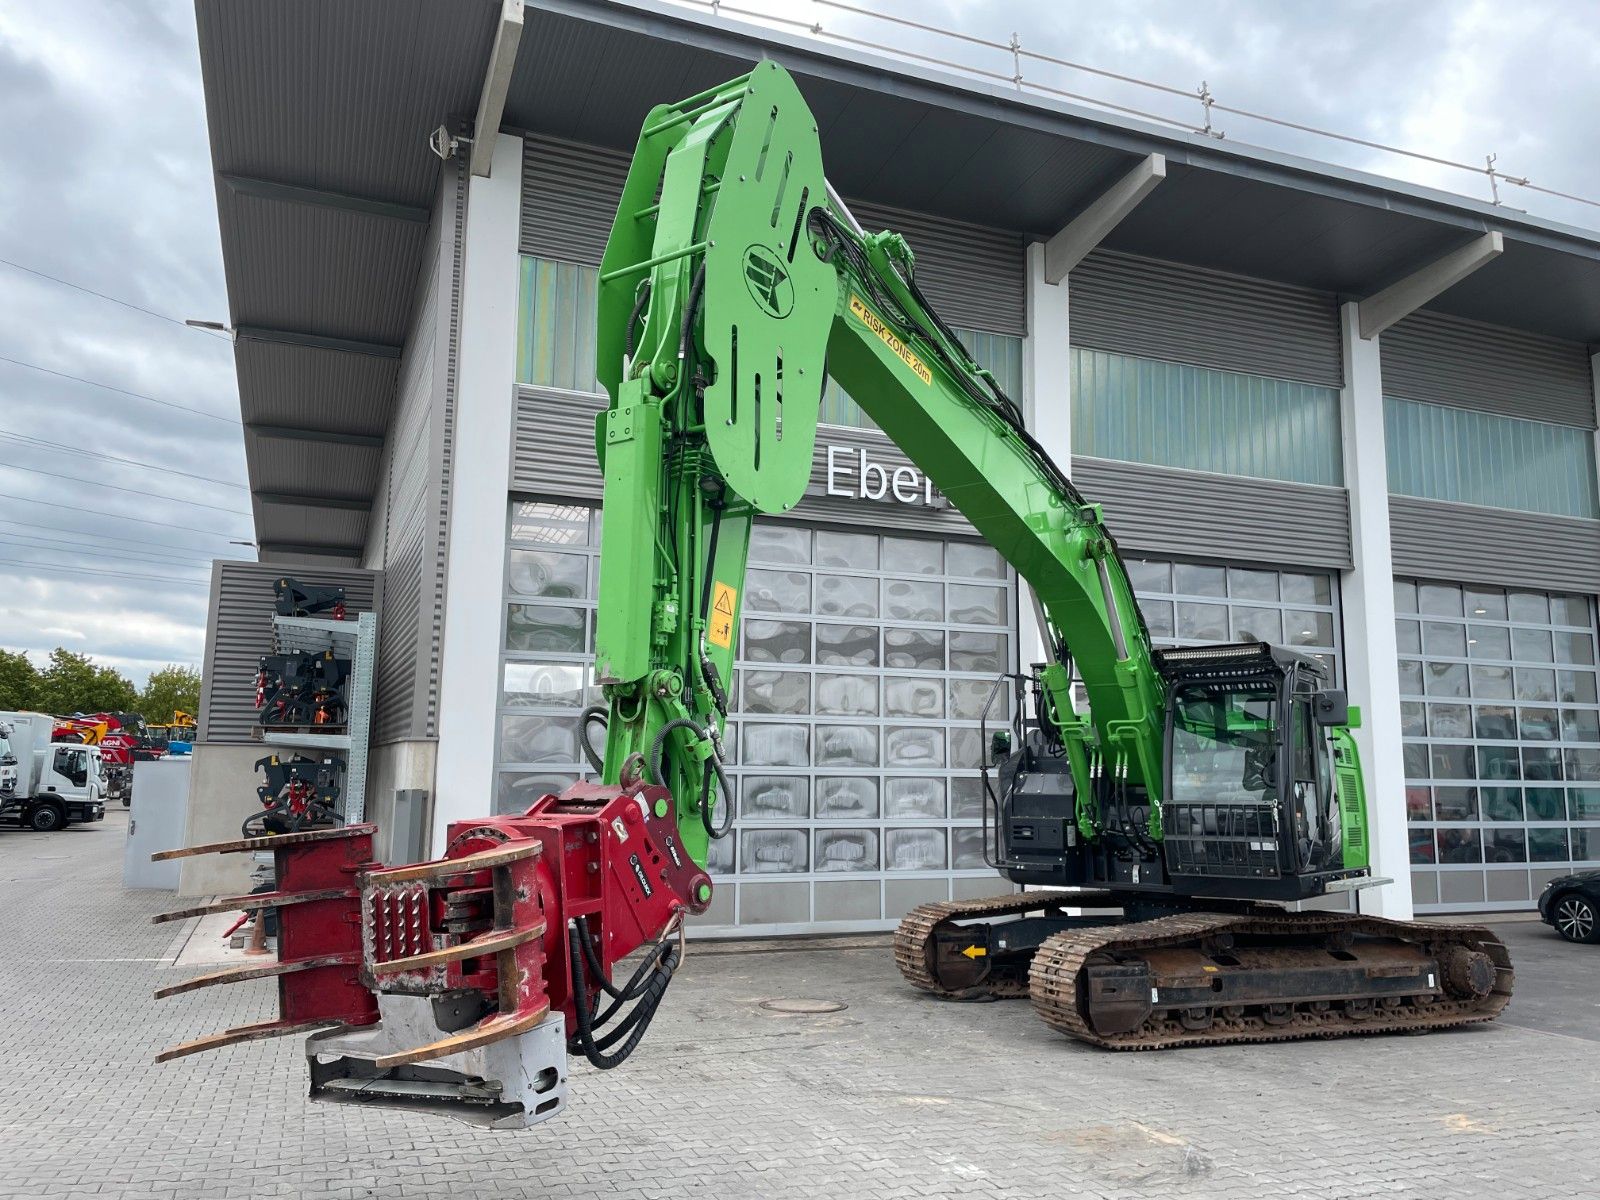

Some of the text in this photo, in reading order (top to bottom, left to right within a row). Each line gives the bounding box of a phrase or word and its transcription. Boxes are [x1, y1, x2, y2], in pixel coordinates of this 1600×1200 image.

[863, 309, 930, 383] RISK ZONE 20m
[827, 445, 933, 504] Eber
